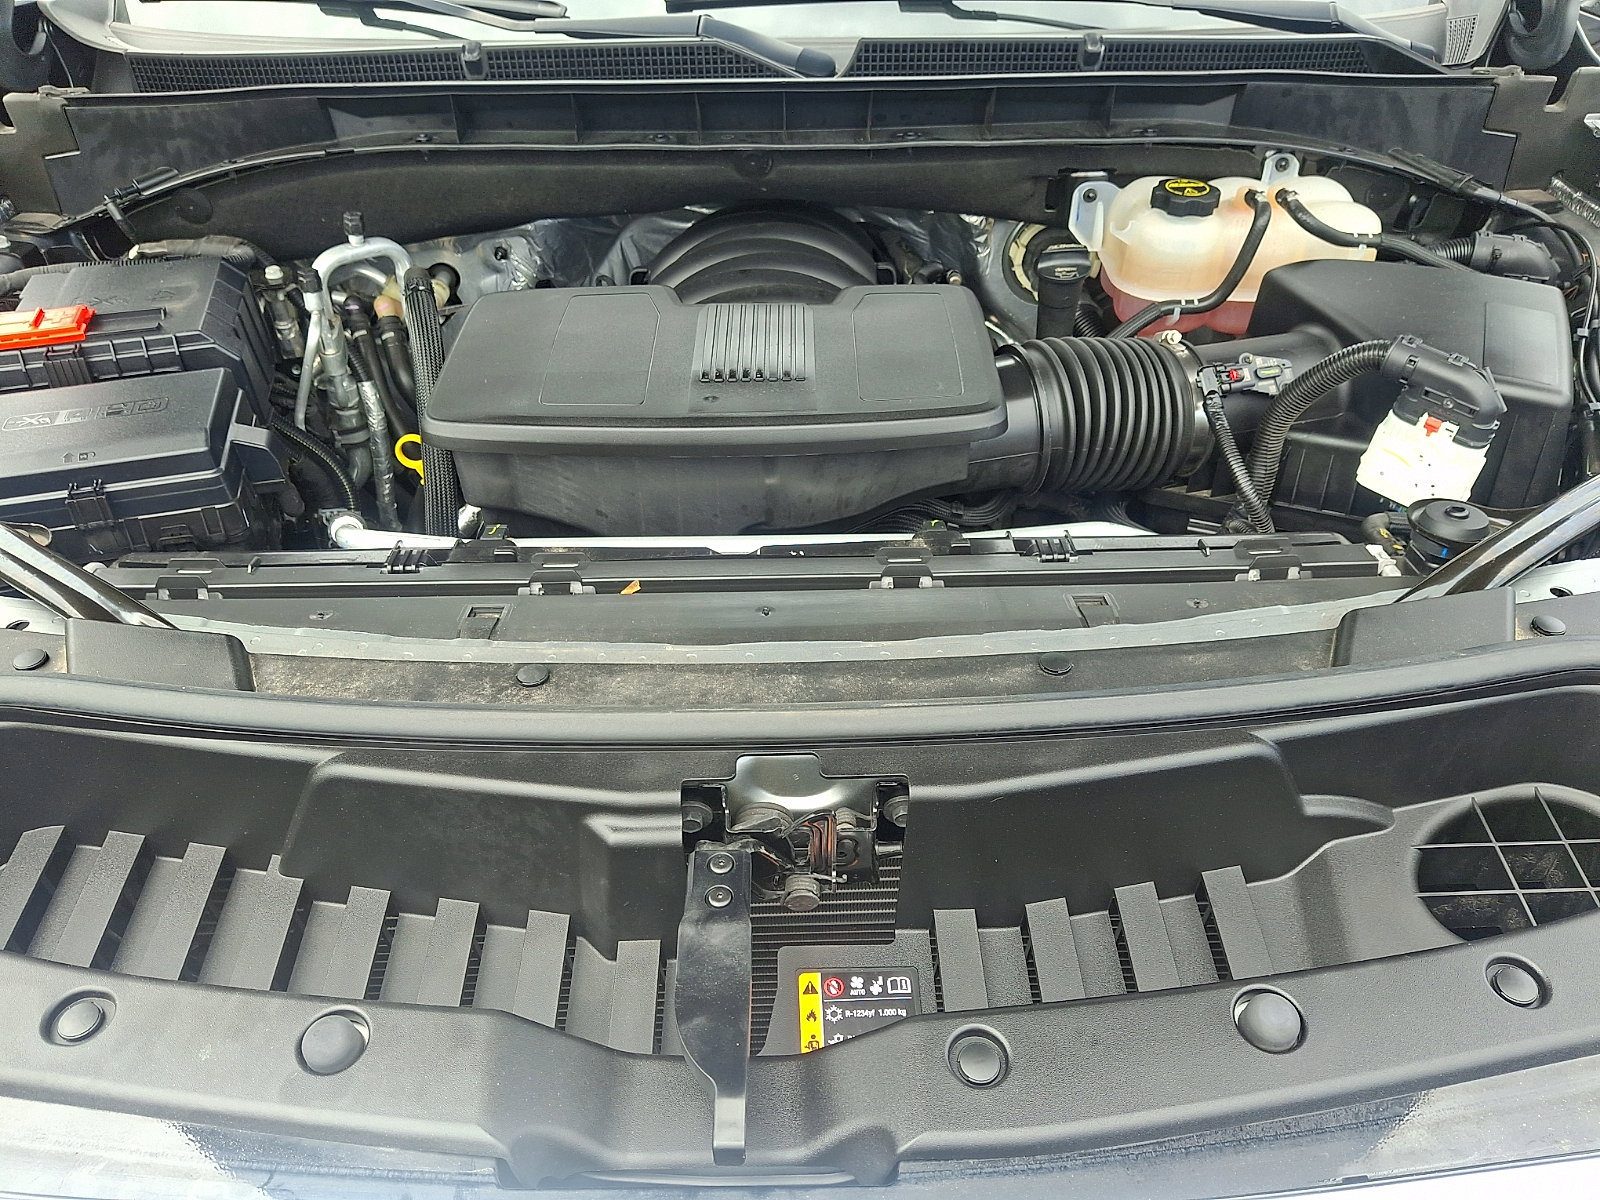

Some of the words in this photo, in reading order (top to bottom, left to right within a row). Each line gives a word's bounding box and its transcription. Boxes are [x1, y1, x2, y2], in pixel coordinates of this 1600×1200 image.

[845, 1009, 875, 1018] R-1234yf
[878, 1009, 897, 1017] 1.000
[898, 1008, 907, 1017] kg
